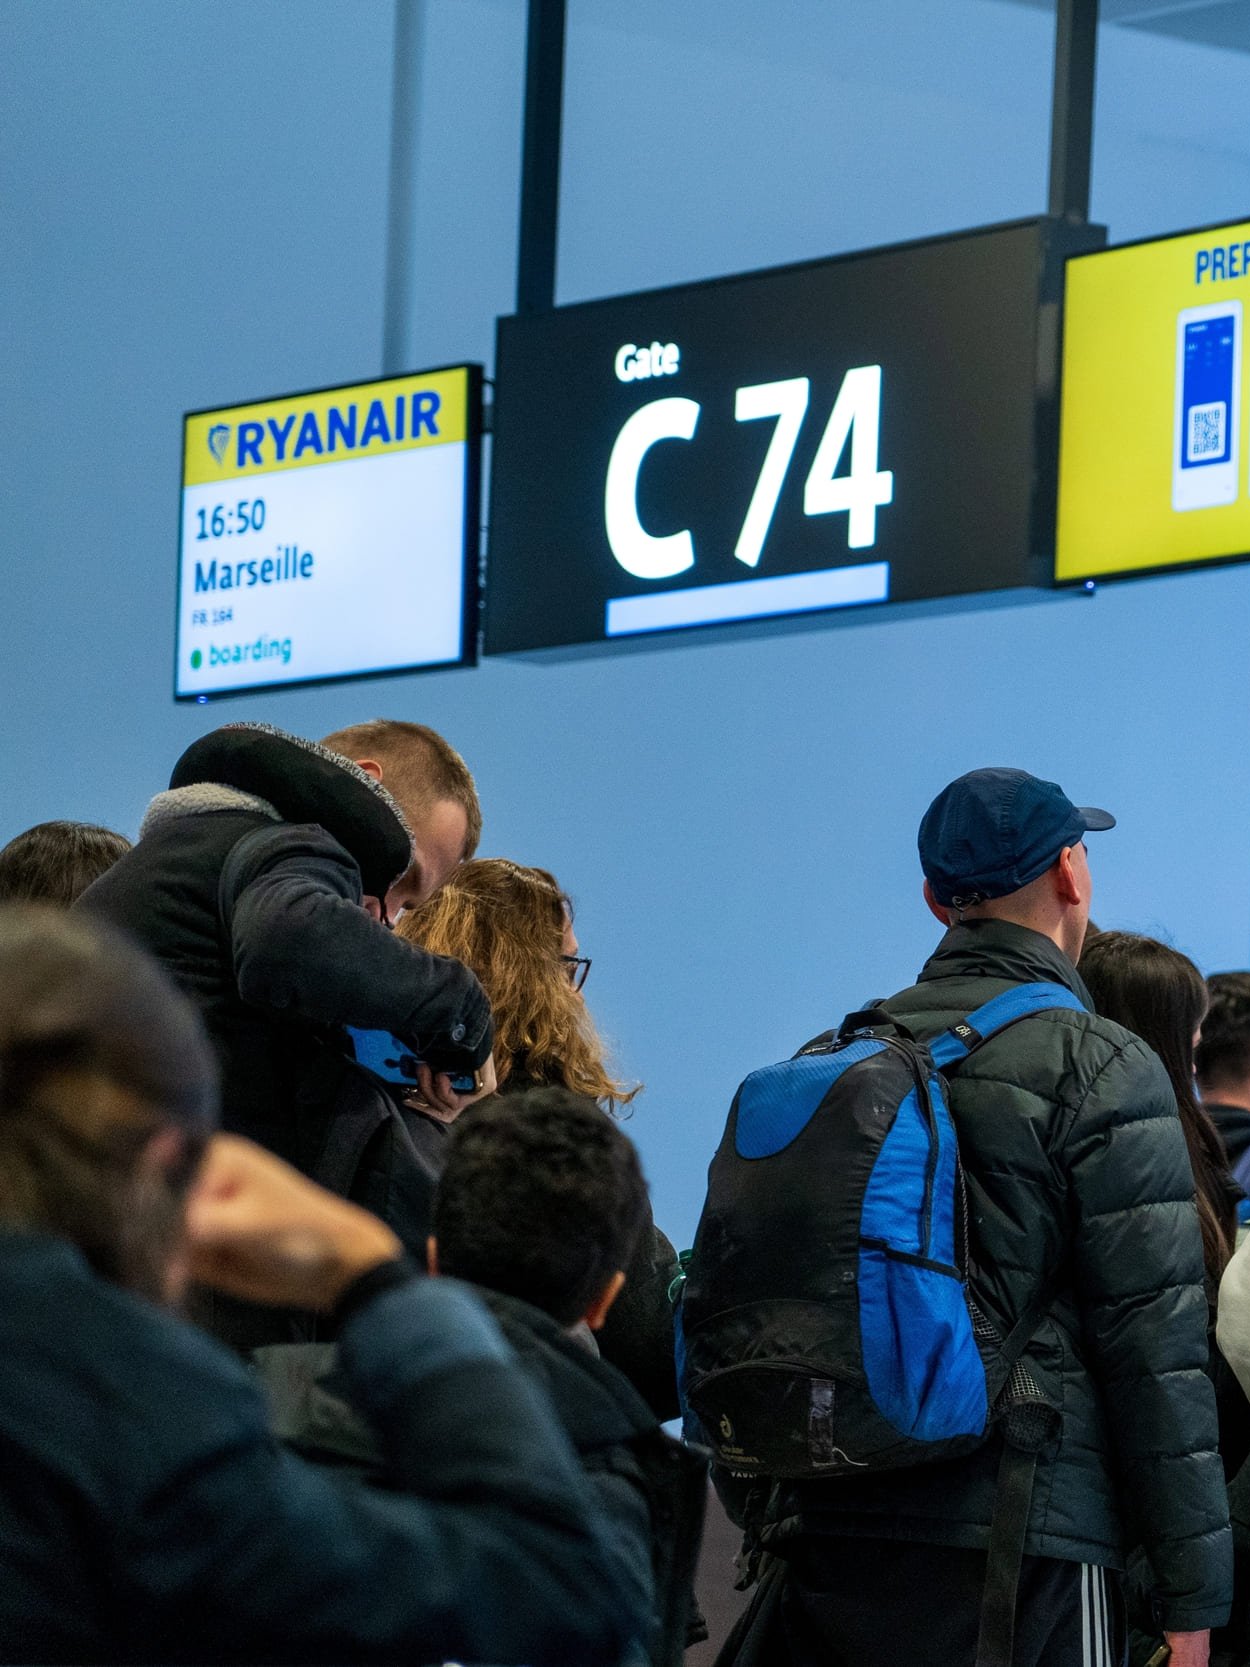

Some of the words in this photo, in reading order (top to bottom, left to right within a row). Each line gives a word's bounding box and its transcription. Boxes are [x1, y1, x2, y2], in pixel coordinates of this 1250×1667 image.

[615, 342, 680, 383] Gate
[235, 390, 441, 468] RYANAIR
[605, 397, 701, 580] C
[734, 365, 894, 568] 74
[196, 499, 266, 540] 16:50
[194, 546, 314, 593] Marseille
[209, 636, 291, 666] boarding
